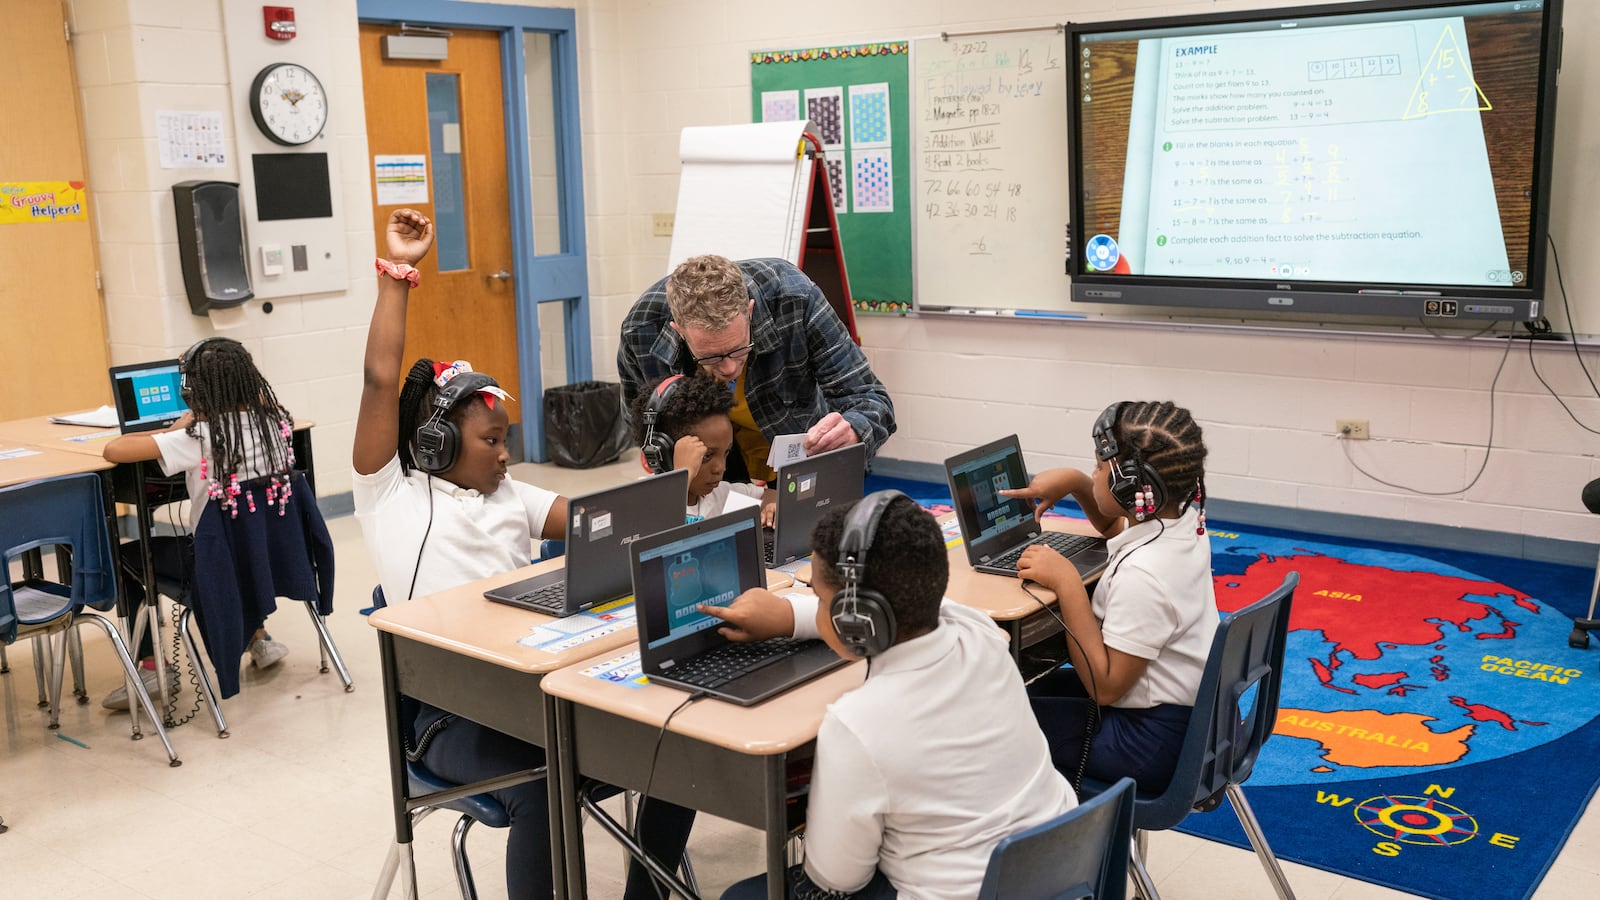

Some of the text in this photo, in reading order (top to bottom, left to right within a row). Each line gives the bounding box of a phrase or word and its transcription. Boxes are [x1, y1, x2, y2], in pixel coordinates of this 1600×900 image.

[1175, 45, 1218, 57] EXAMPLE
[1437, 48, 1456, 70] 15
[286, 68, 295, 78] 12
[1173, 83, 1194, 91] Count
[1228, 80, 1244, 88] from
[1247, 92, 1266, 100] many
[1268, 91, 1281, 99] you
[1283, 89, 1312, 97] counted
[1458, 86, 1473, 105] 7
[1172, 106, 1190, 114] Solve
[1205, 104, 1235, 112] addition
[1171, 118, 1190, 126] Solve
[1205, 115, 1246, 124] subtraction
[1209, 141, 1234, 149] blanks
[1243, 140, 1262, 148] each
[923, 179, 943, 197] 72
[965, 179, 981, 197] 60
[985, 180, 1001, 198] 54
[1008, 183, 1022, 198] 48
[11, 192, 56, 208] Groovy
[1220, 197, 1234, 205] the
[32, 203, 81, 220] Helpers!
[926, 203, 942, 220] 42
[983, 203, 998, 219] 24
[1006, 206, 1017, 223] 18
[1221, 217, 1234, 225] the
[1258, 217, 1268, 225] as
[1171, 236, 1208, 246] Complete
[1209, 235, 1230, 244] each
[1231, 234, 1265, 243] addition
[1266, 234, 1282, 243] fact
[1293, 234, 1314, 242] solve
[1316, 233, 1330, 241] the
[1331, 231, 1380, 241] subtraction
[1207, 530, 1239, 539] EAN
[1312, 589, 1363, 603] ASIA
[1480, 663, 1570, 685] OCEAN
[1482, 655, 1583, 678] PACIFIC
[1279, 714, 1430, 753] AUSTRALIA
[1315, 790, 1354, 807] W
[1424, 784, 1455, 798] N
[1489, 832, 1521, 849] E
[1372, 841, 1403, 857] S
